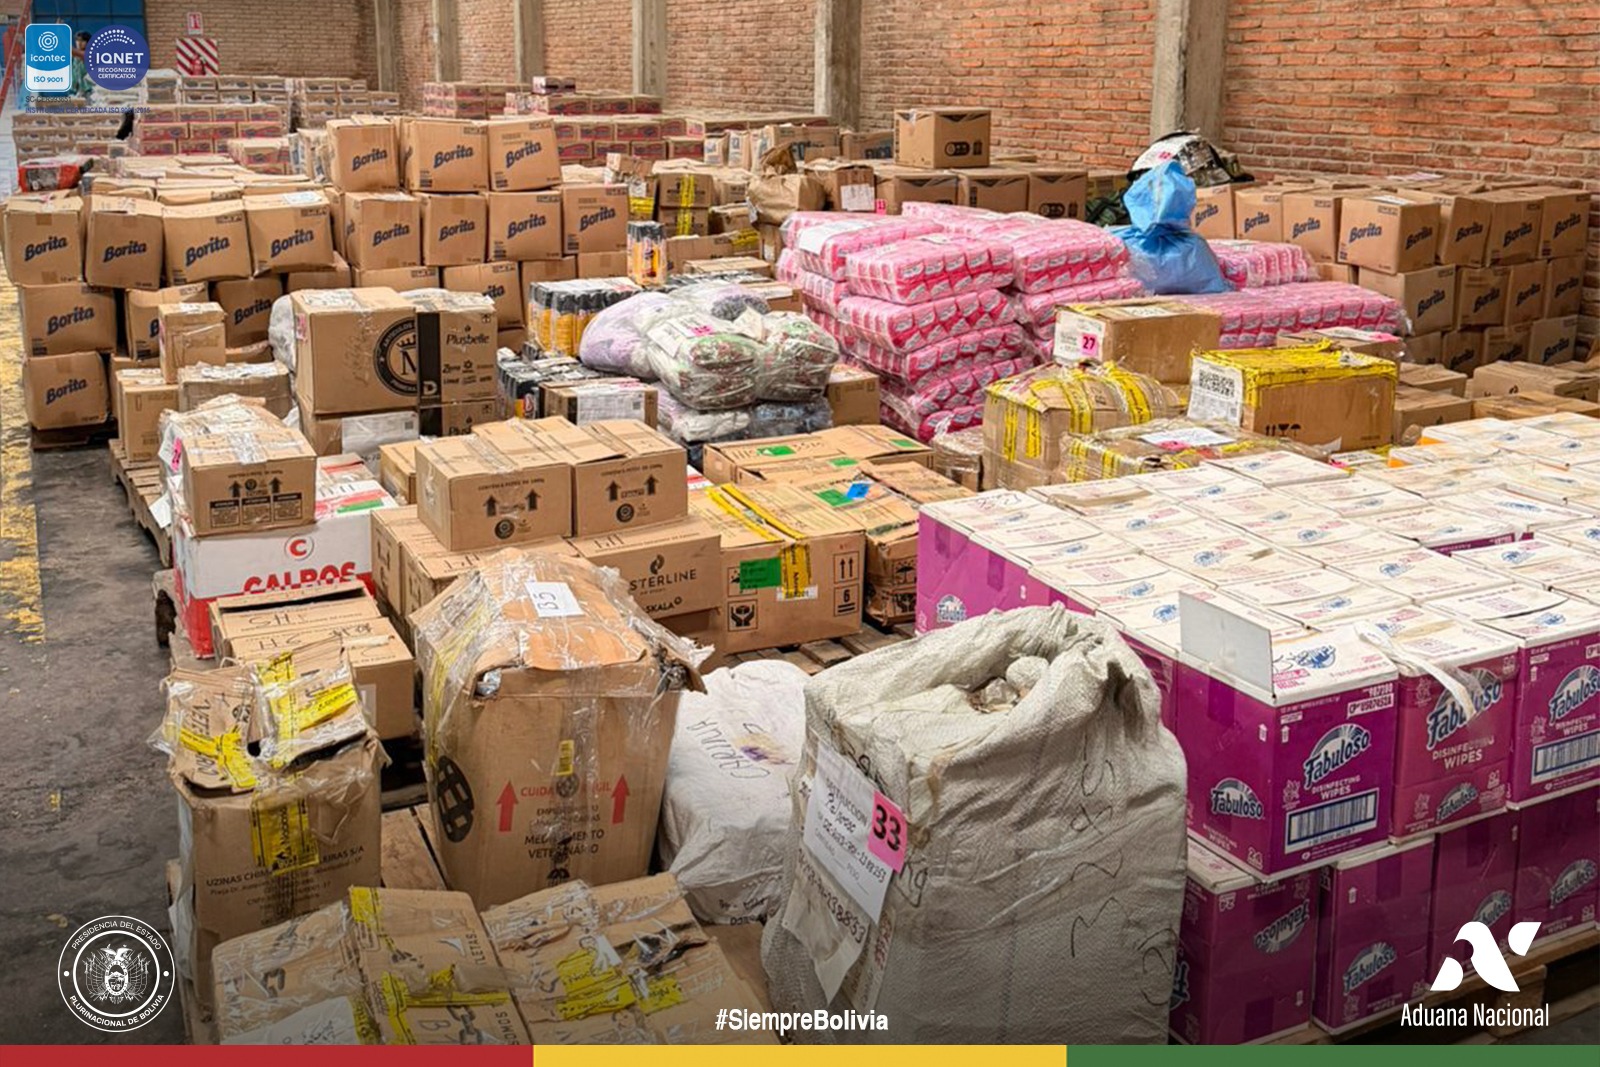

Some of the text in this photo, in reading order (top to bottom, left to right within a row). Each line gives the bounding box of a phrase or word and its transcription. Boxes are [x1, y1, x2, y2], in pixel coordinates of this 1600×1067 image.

[352, 148, 388, 171] Borita
[433, 144, 474, 168] Borita
[506, 140, 542, 168] Borita
[439, 219, 475, 241] Borita
[507, 213, 547, 239] Borita
[579, 206, 616, 231] Borita
[1244, 210, 1270, 233] Borita
[1292, 216, 1321, 238] Borita
[1554, 213, 1581, 238] Borita
[271, 228, 314, 258] Borita
[373, 222, 410, 247] Borita
[1348, 222, 1382, 243] Borita
[1405, 226, 1433, 250] Borita
[1455, 223, 1484, 242] Borita
[1503, 222, 1533, 248] Borita
[24, 236, 67, 261] Borita
[104, 240, 147, 263] Borita
[186, 236, 230, 267] Borita
[1416, 290, 1446, 318] Borita
[48, 306, 95, 335] Borita
[1082, 336, 1096, 350] 27
[46, 377, 87, 405] Borita
[1563, 723, 1589, 737] WIPES
[1303, 729, 1371, 790] Fabuloso
[1443, 749, 1484, 770] WIPES
[1311, 774, 1361, 794] DISINFECTING
[1320, 785, 1352, 800] WIPES
[1210, 788, 1264, 820] Fabuloso
[873, 804, 901, 852] 33
[206, 875, 243, 887] UZINAS
[1254, 898, 1310, 947] Fabuloso
[1342, 948, 1397, 997] Fabuloso
